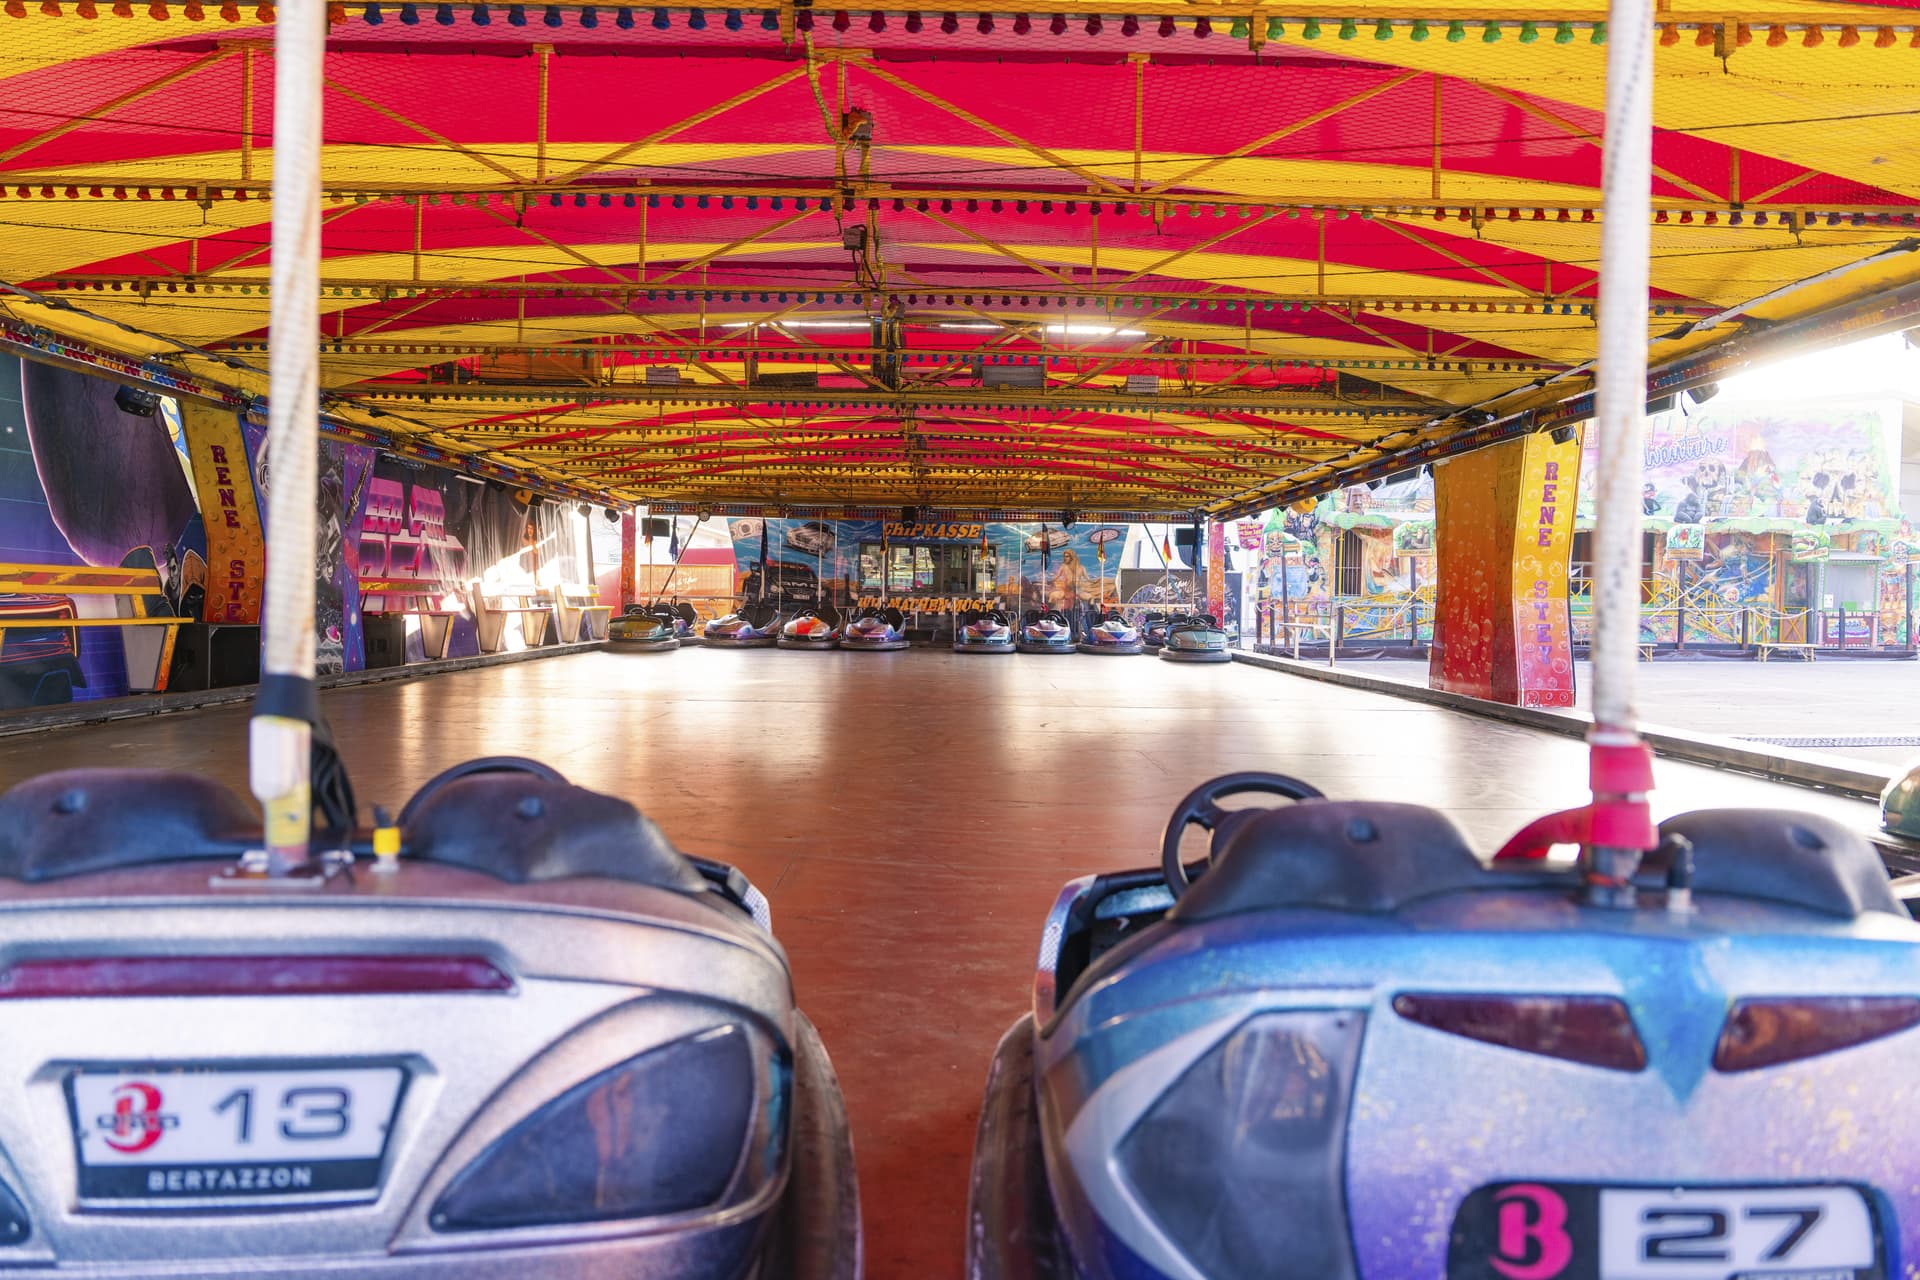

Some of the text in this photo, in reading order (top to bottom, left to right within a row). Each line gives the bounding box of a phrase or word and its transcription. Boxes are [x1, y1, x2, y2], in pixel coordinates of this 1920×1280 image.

[211, 445, 246, 622] RENE STE
[1533, 462, 1559, 664] RENE STEY
[950, 598, 996, 612] MUSK
[212, 1085, 353, 1144] 13
[148, 1167, 311, 1191] BERTAZZON
[1637, 1205, 1830, 1264] 27
